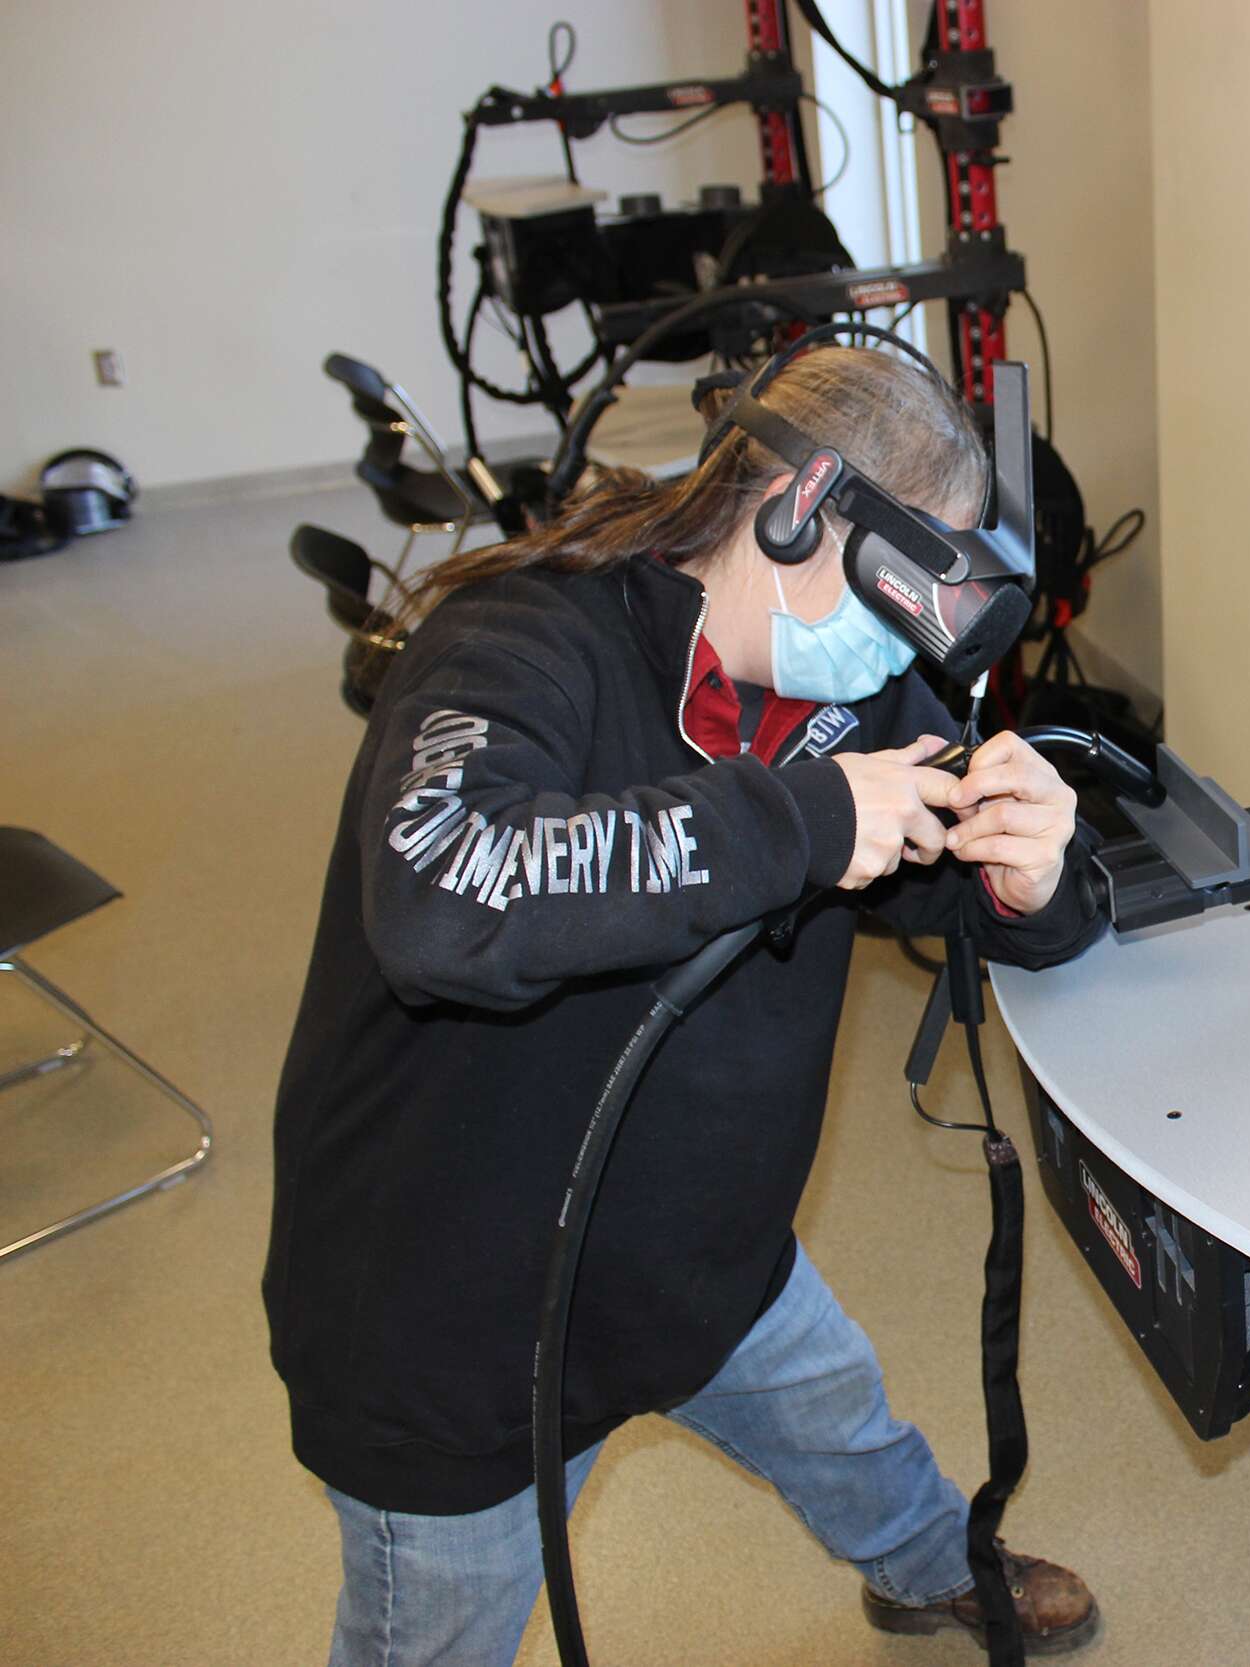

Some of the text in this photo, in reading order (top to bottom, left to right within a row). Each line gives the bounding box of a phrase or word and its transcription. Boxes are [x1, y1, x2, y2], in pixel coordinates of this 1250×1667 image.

[879, 569, 919, 602] LINCOLN
[811, 707, 846, 743] BIW
[1082, 1168, 1129, 1251] LINCOLN
